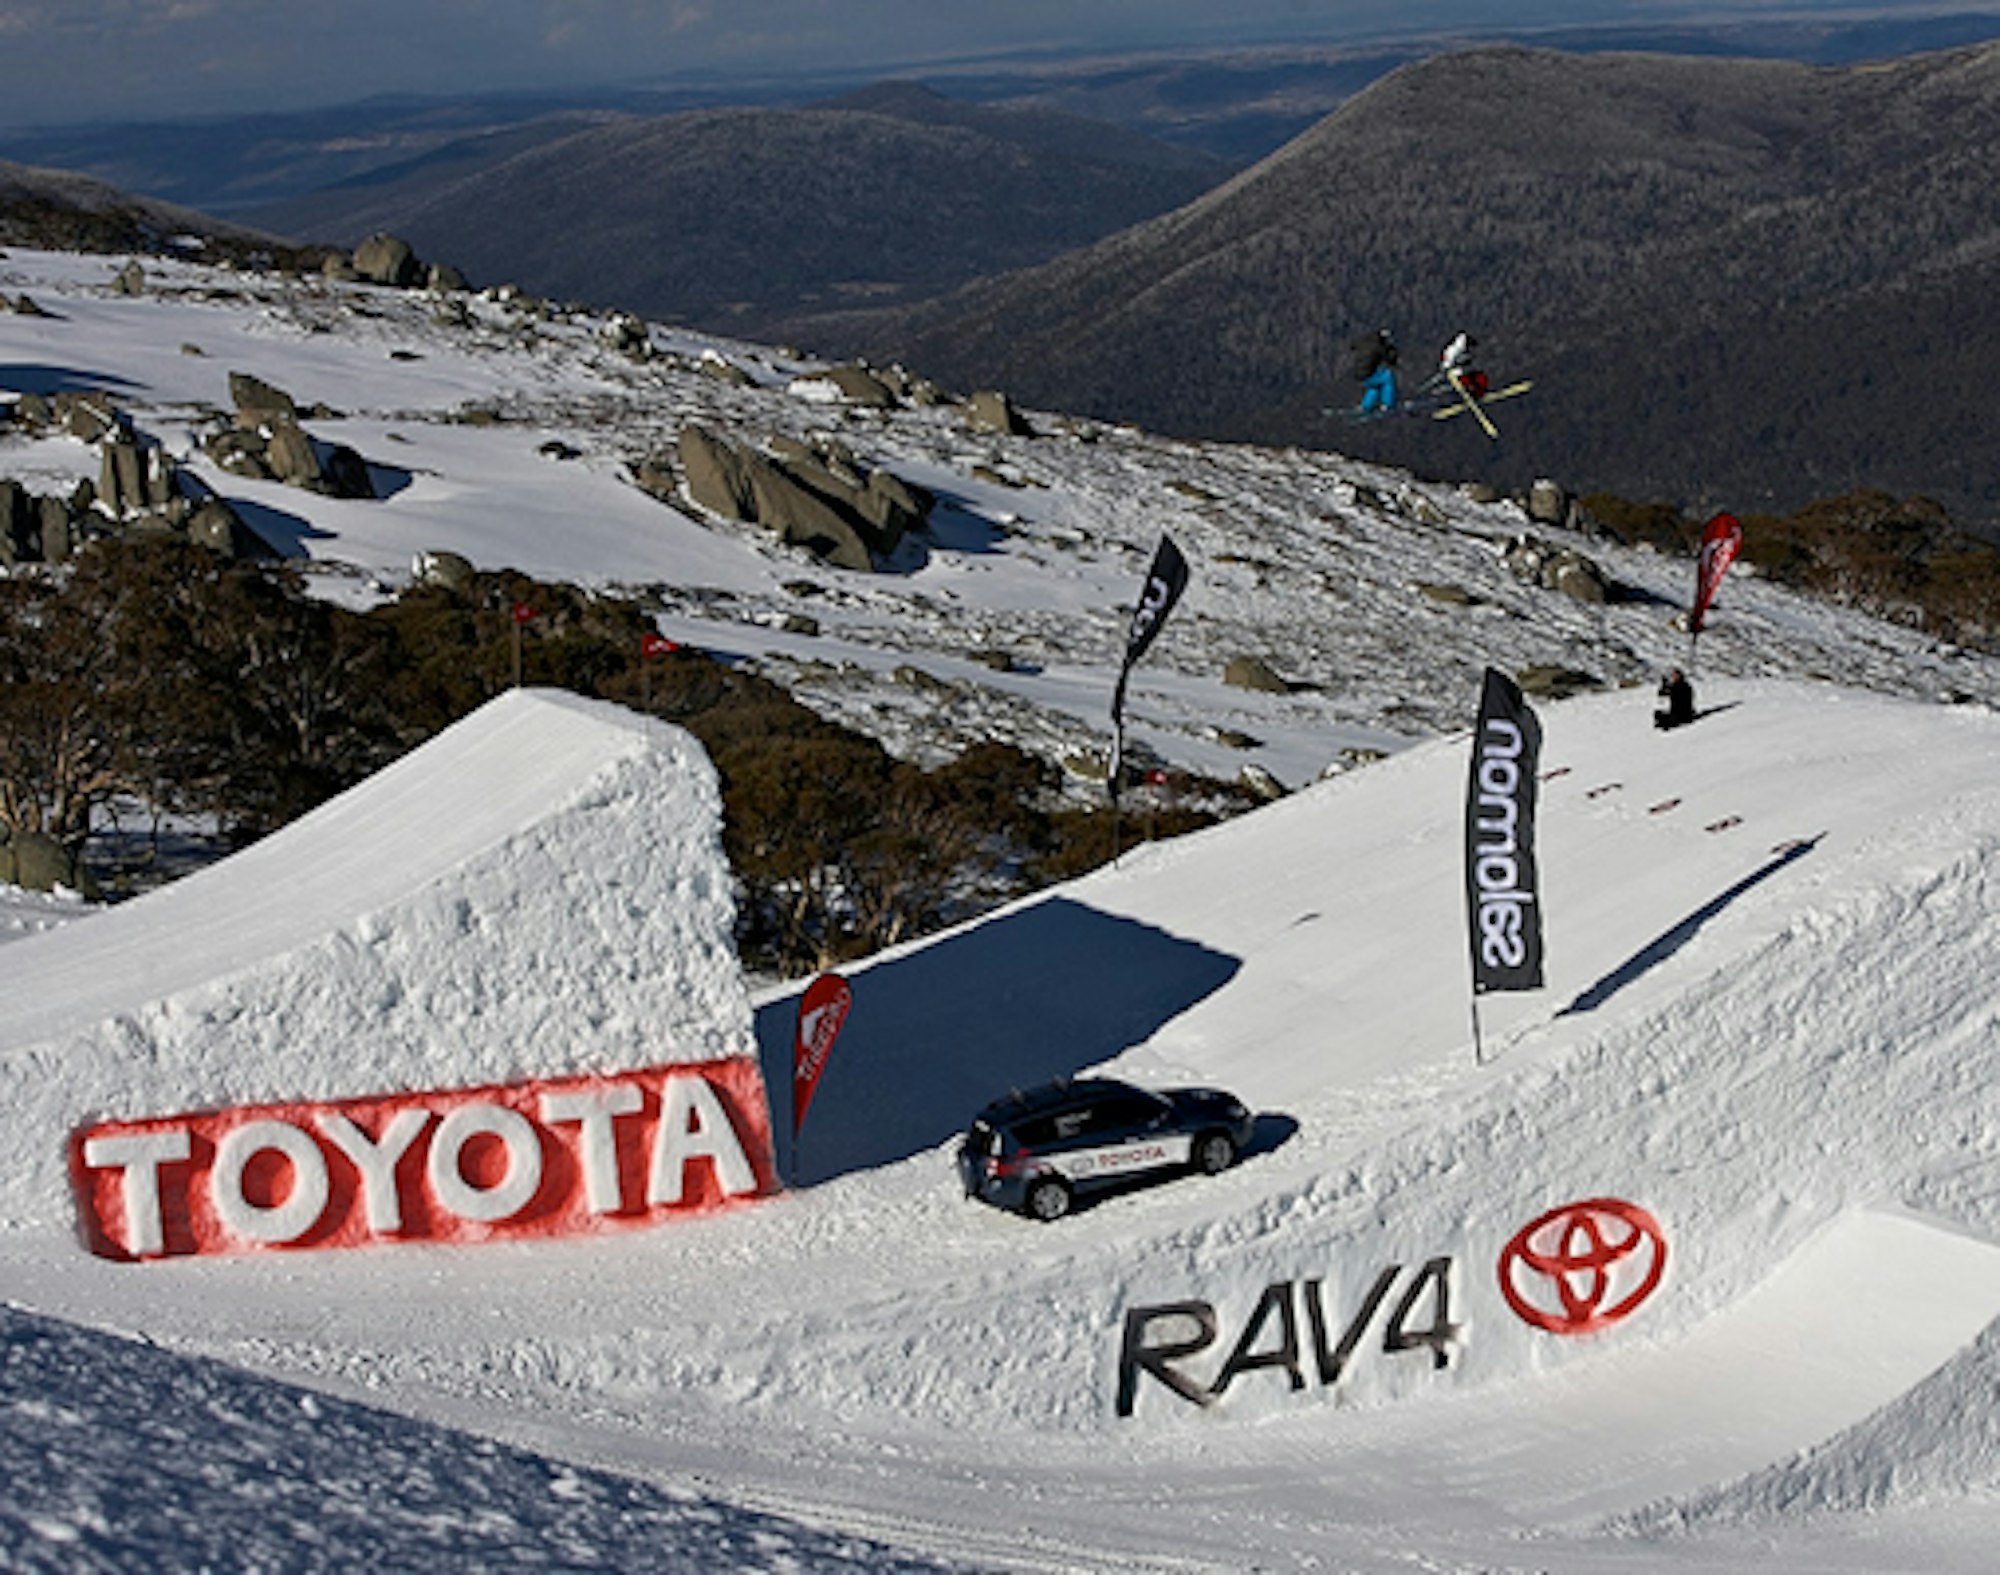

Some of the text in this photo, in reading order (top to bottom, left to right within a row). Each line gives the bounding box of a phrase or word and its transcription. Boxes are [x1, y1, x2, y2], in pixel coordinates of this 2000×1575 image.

[84, 1074, 756, 1256] TOYOTA
[1098, 1146, 1166, 1166] TOYOTA
[1117, 1257, 1461, 1416] RAV4
